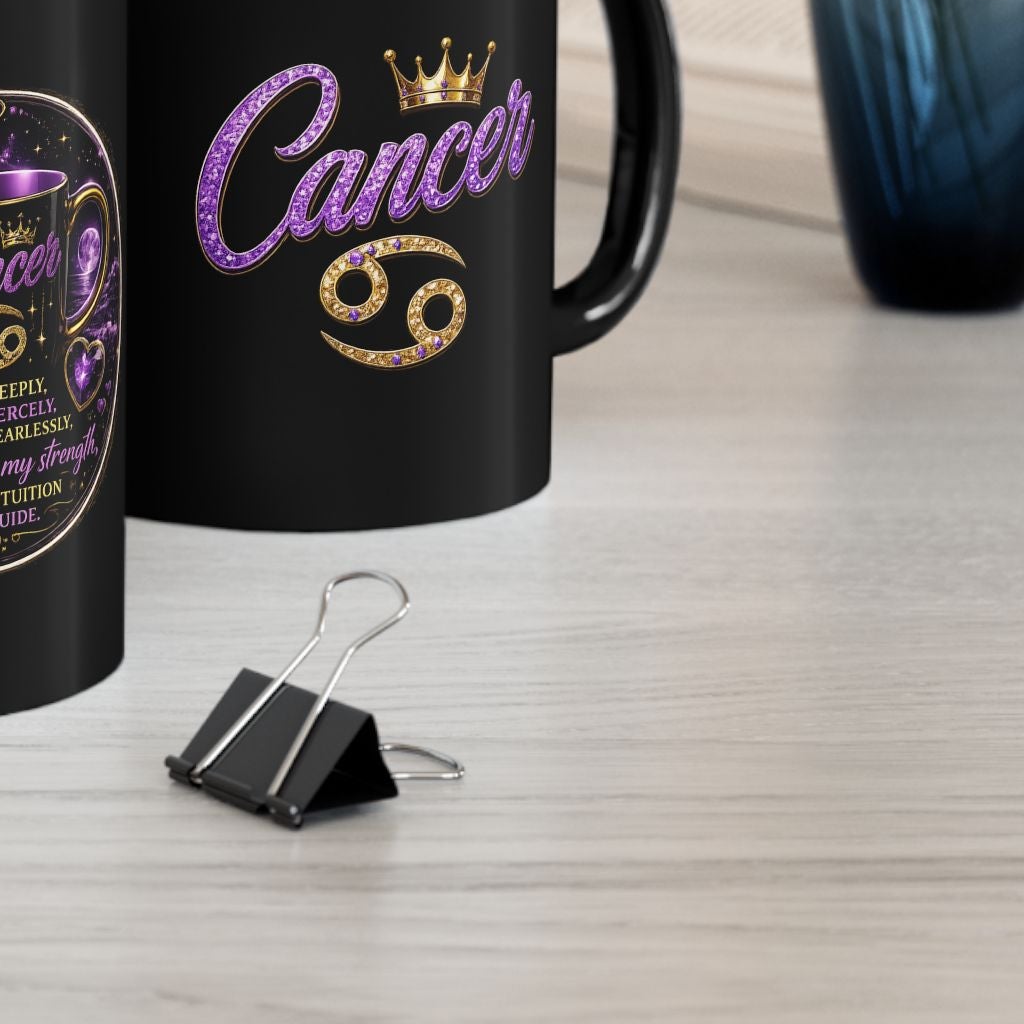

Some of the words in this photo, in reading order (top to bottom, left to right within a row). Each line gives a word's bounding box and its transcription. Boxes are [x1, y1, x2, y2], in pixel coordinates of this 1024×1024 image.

[195, 62, 535, 275] Cancer
[0, 456, 36, 485] my
[38, 423, 98, 475] strength,
